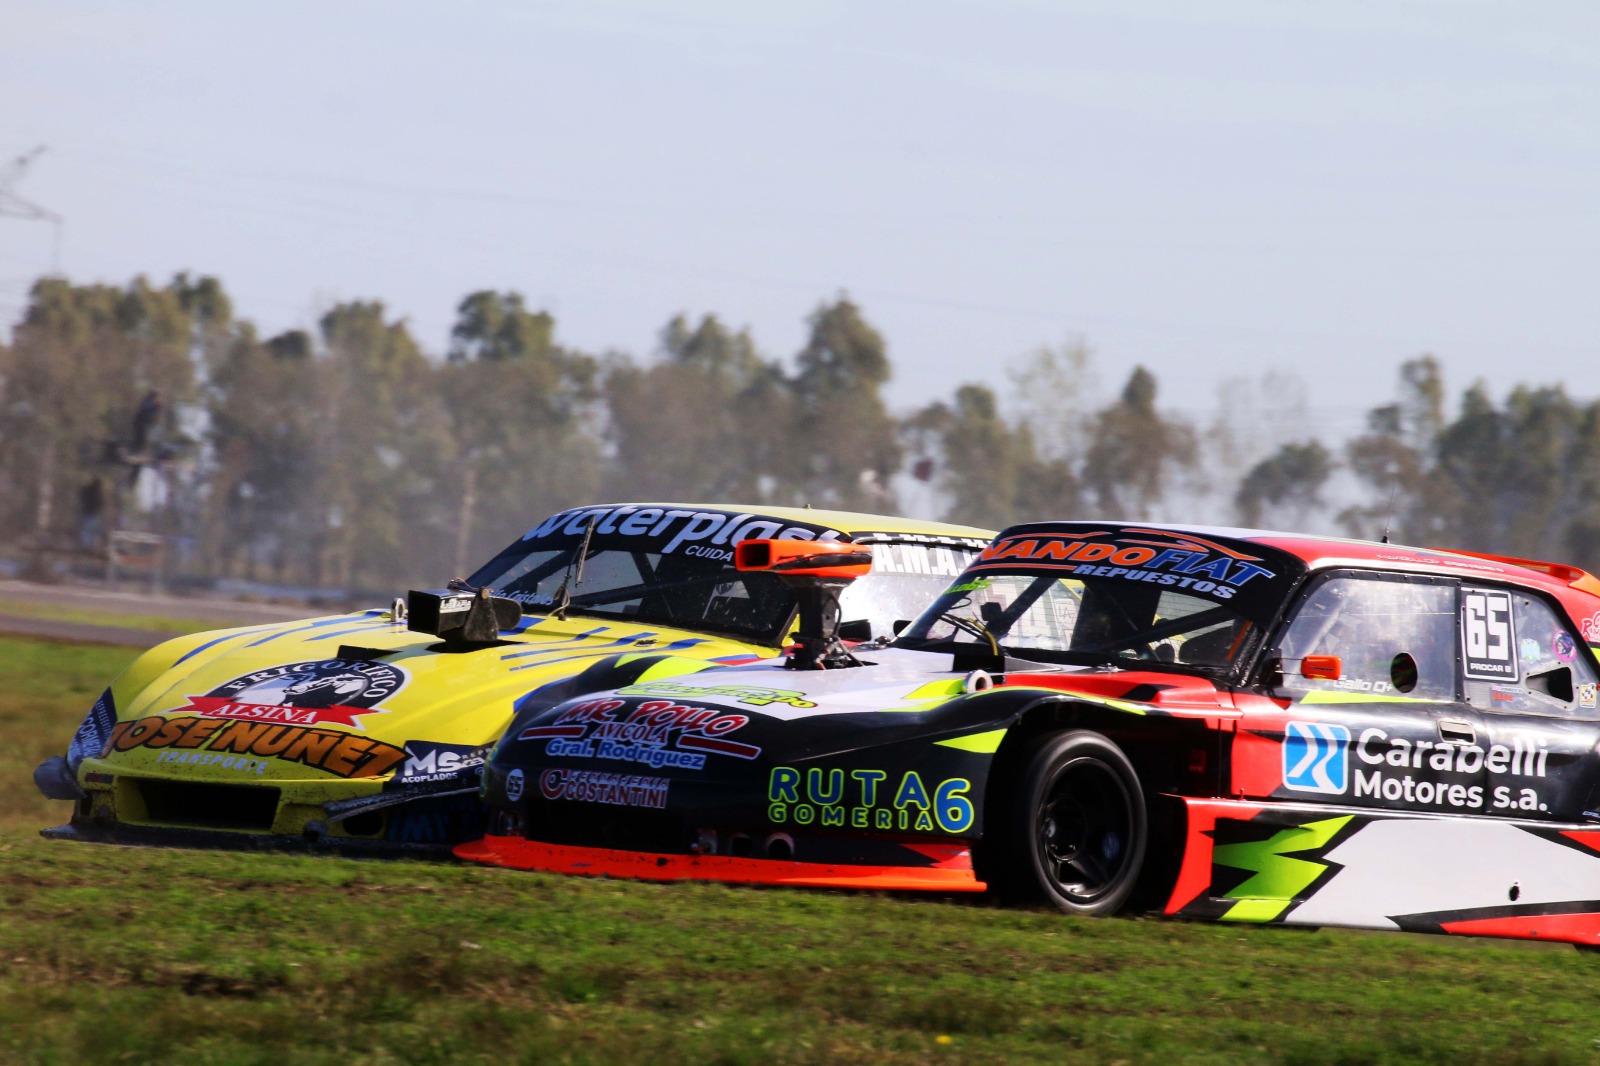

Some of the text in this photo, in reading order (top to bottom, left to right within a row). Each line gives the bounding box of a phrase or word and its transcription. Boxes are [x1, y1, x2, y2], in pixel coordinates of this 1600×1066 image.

[1073, 564, 1238, 599] REPUESTOS
[1466, 595, 1509, 660] 65
[1333, 674, 1372, 691] Gallo
[1469, 662, 1512, 673] PROCAR B
[207, 704, 318, 724] ALSINA
[627, 700, 750, 736] POLLO
[101, 716, 233, 759] JOSE
[546, 738, 596, 758] Gral.
[1356, 727, 1549, 778] Carabelli
[157, 751, 269, 774] TRANSPORTE
[403, 746, 463, 777] MS
[401, 772, 458, 784] ACOPLADOS
[1354, 769, 1549, 812] Motores s.a.
[564, 780, 667, 809] COSTANTINI
[768, 766, 975, 834] RUTA 6
[768, 802, 934, 831] GOMERIA
